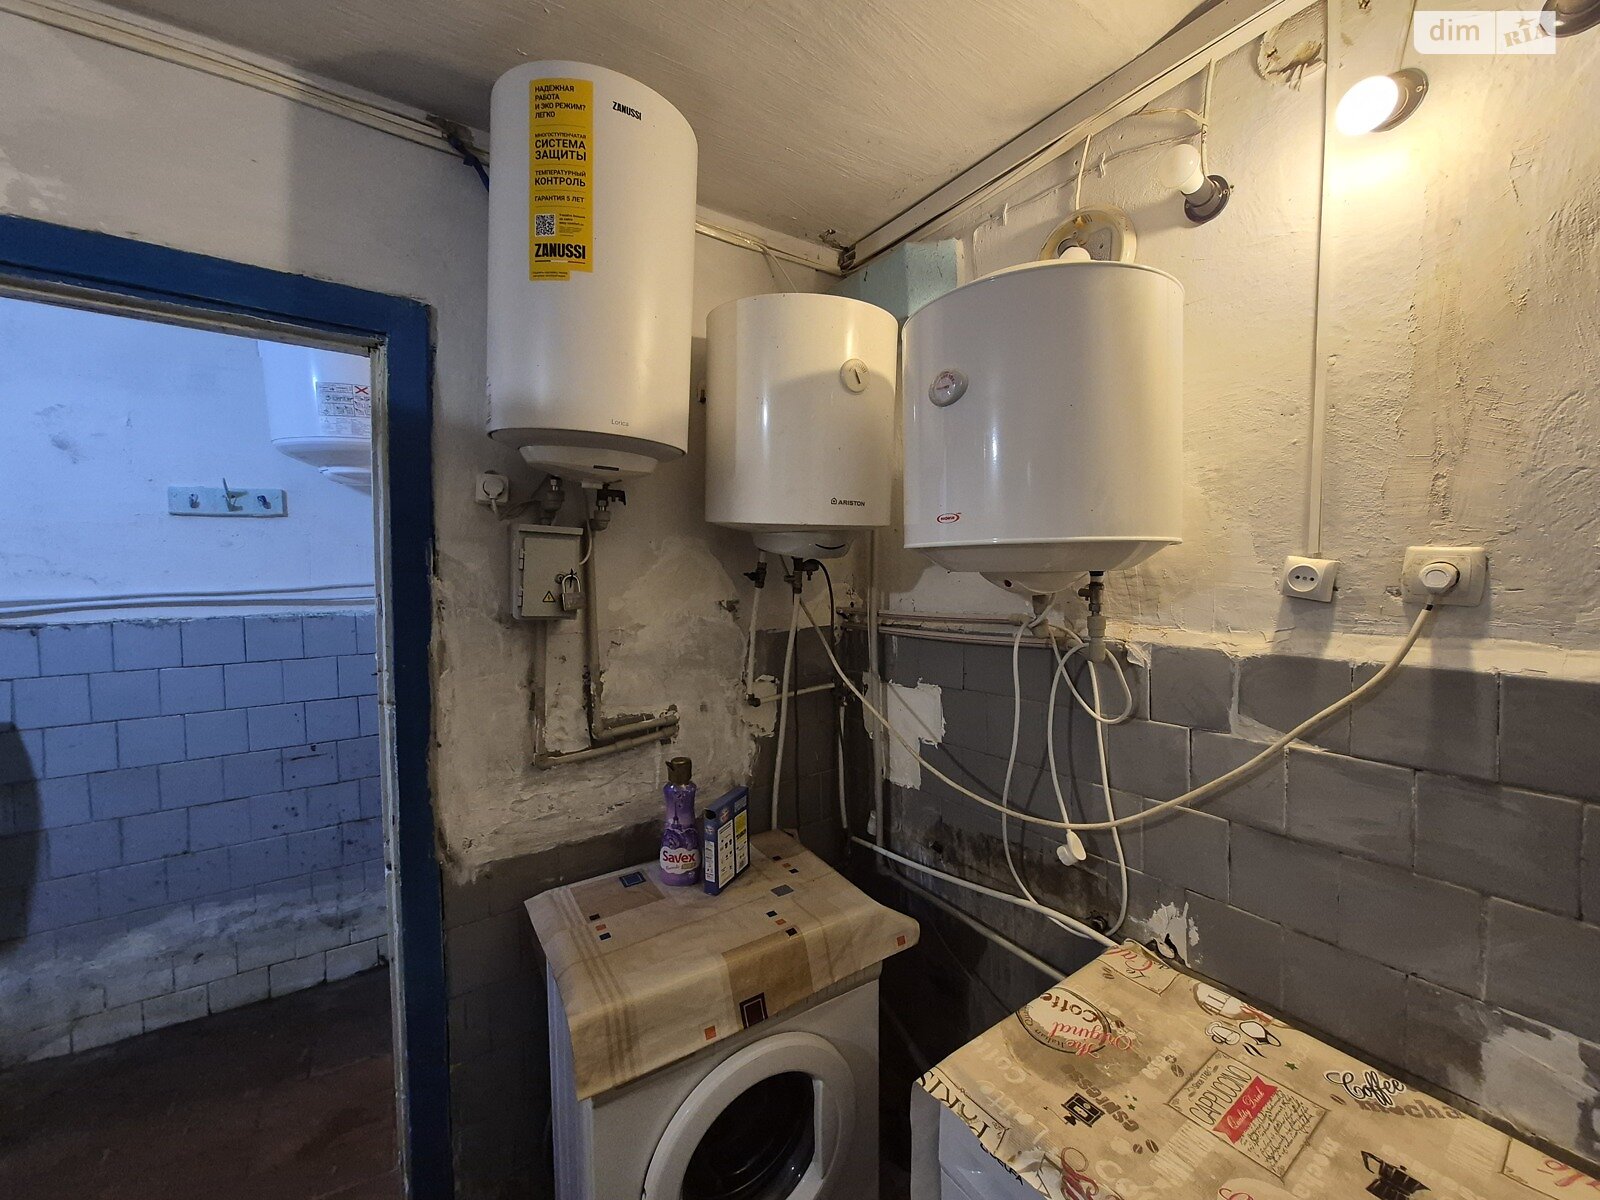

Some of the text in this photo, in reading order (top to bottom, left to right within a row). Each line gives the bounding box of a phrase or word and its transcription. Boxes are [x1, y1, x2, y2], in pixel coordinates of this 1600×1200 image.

[534, 84, 575, 92] НАДЕЖНАЯ
[534, 93, 560, 101] РАБОТА
[540, 102, 554, 110] ЭКО
[555, 102, 586, 111] РЕЖИМ?
[612, 100, 642, 121] ZANUSSI
[535, 110, 556, 119] ЛЕГКО
[534, 132, 587, 140] МНОГОСТУПЕНЧАТАЯ
[534, 139, 586, 150] СИСТЕМА
[535, 149, 587, 161] ЗАЩИТЫ
[535, 169, 587, 177] ТЕМПЕРАТУРНЫЙ
[534, 177, 586, 187] КОНТРОЛЬ
[534, 242, 586, 260] ZANUSSI
[662, 850, 697, 864] Savex
[1047, 1021, 1133, 1052] Original
[1066, 1039, 1101, 1059] The
[1326, 1070, 1405, 1107] Coffee
